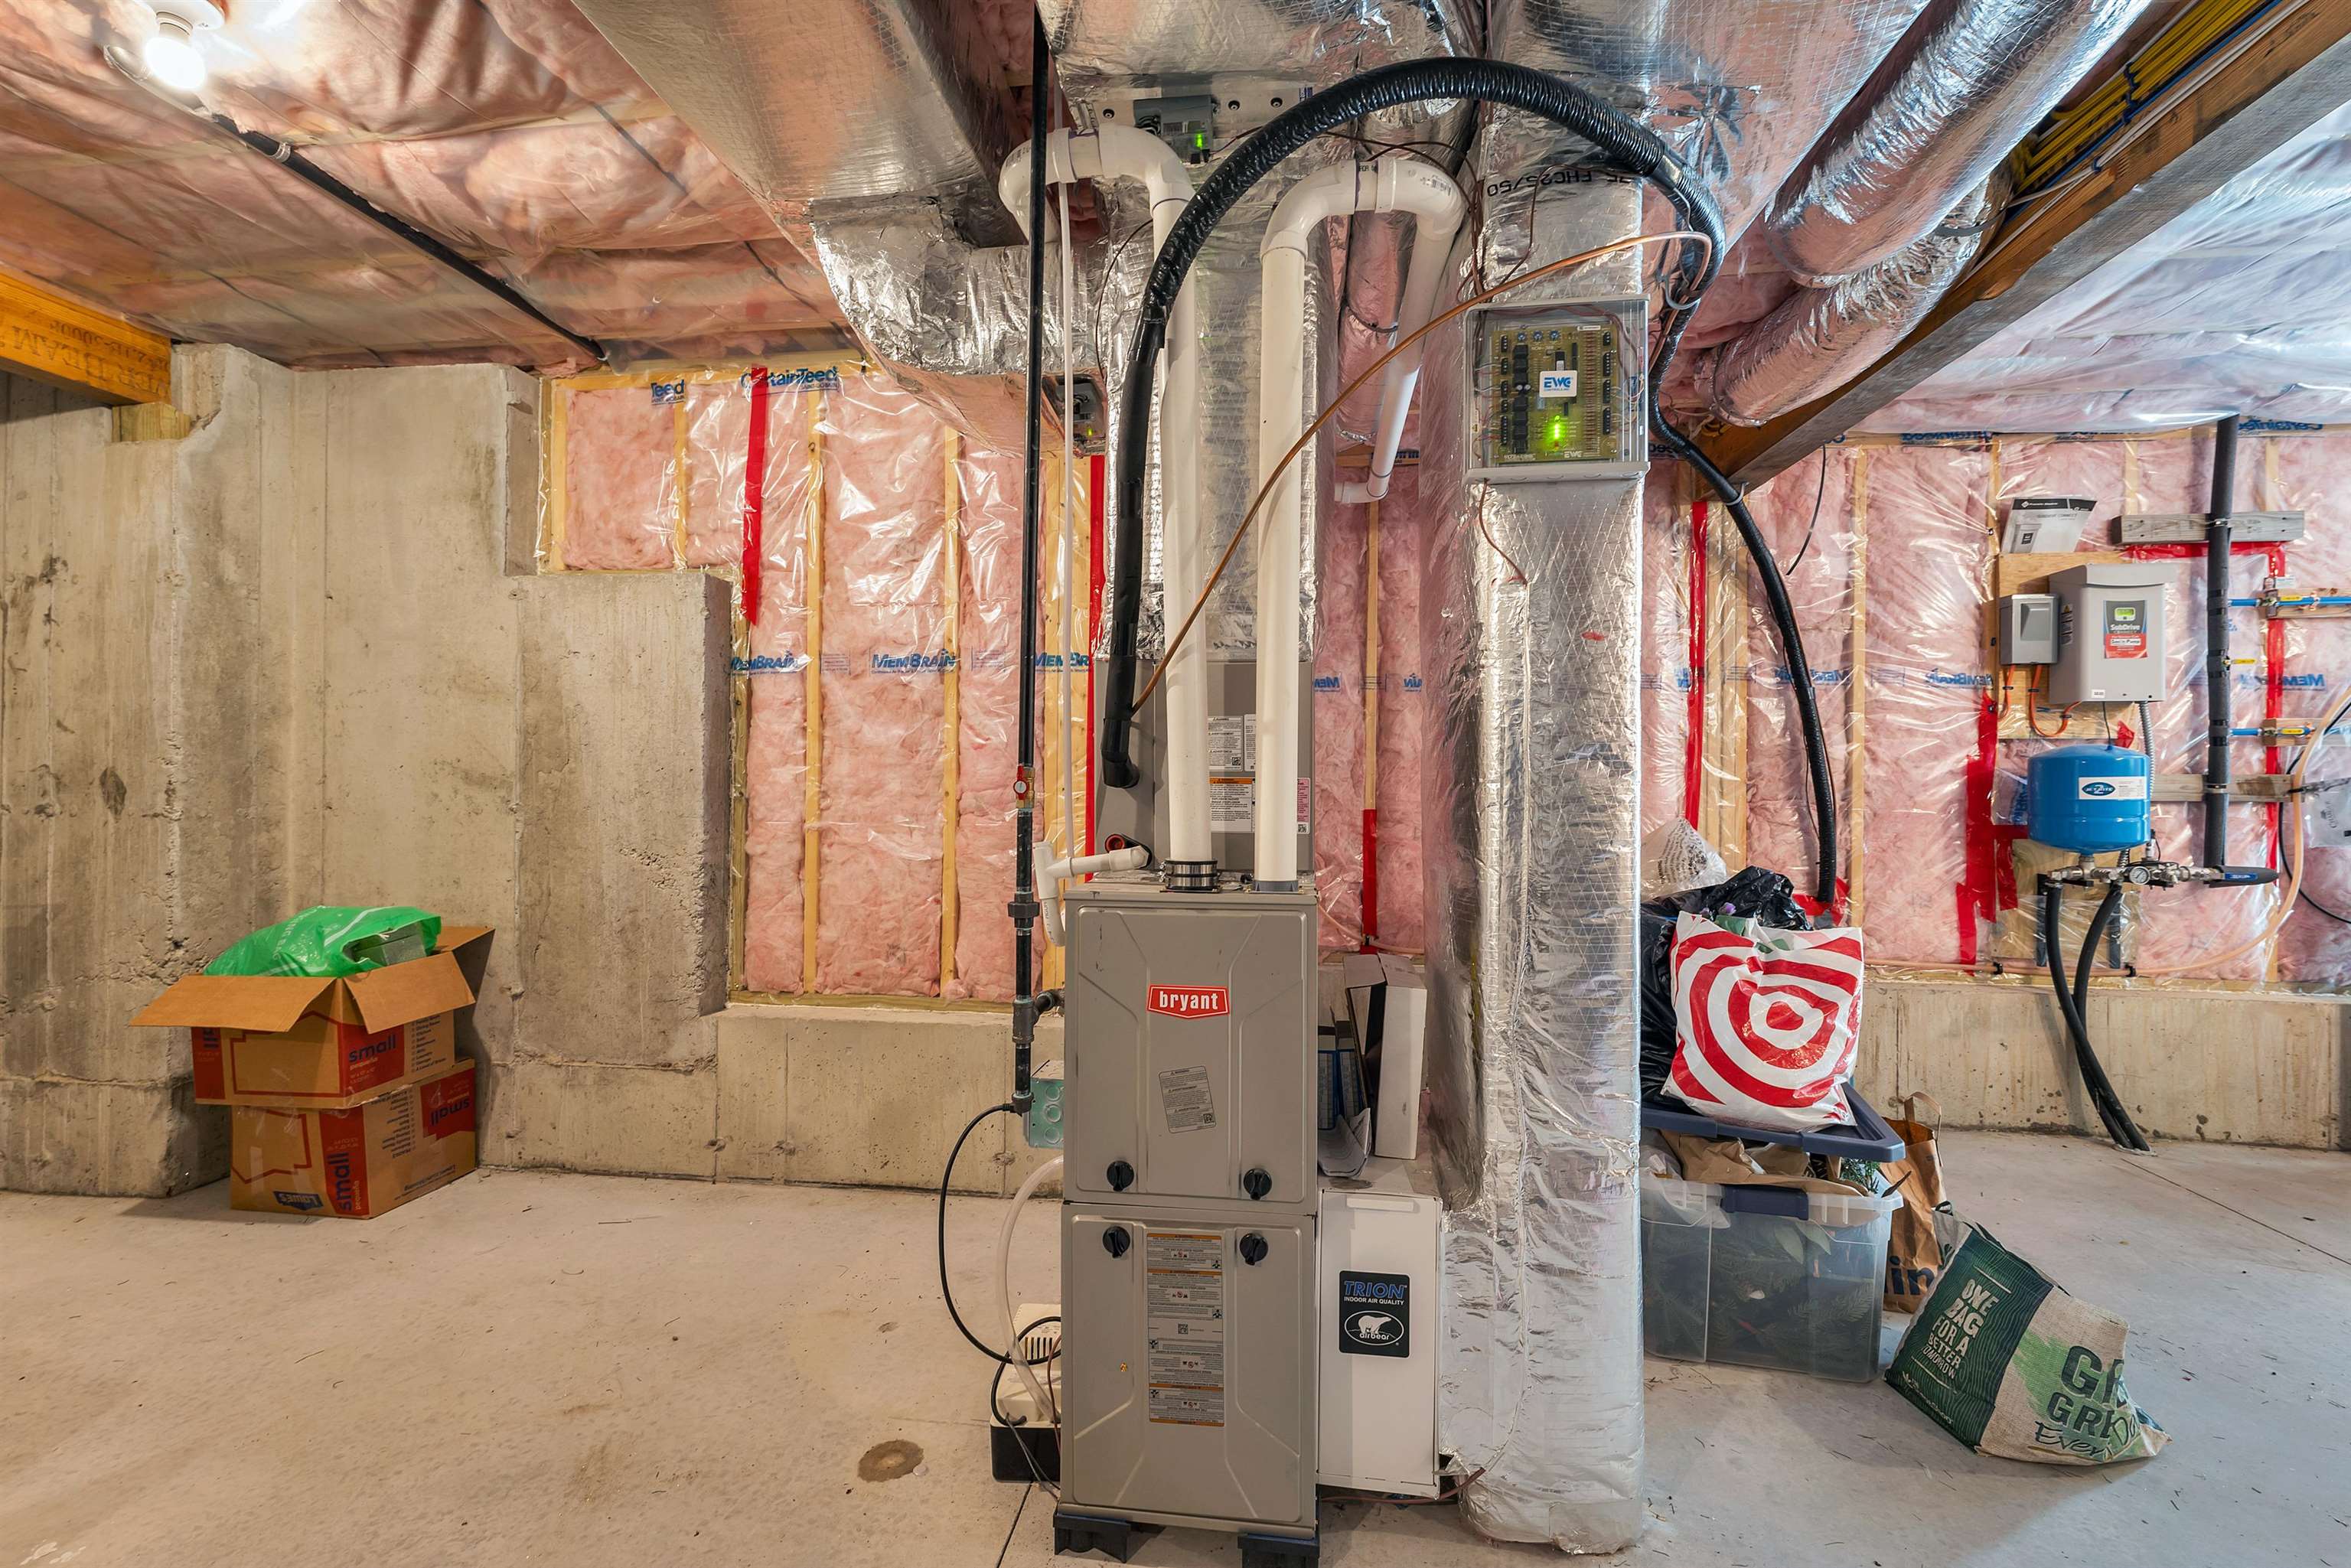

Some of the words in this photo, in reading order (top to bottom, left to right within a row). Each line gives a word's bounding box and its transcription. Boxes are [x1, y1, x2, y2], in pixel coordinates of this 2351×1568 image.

[740, 366, 838, 389] CtainTeed
[1544, 377, 1571, 388] EWC
[1159, 990, 1218, 1012] bryant
[349, 1034, 396, 1062] small
[431, 1097, 470, 1126] small
[327, 1152, 353, 1212] small
[1344, 1280, 1405, 1299] TRION
[1961, 1279, 2000, 1317] ONE
[1945, 1297, 1984, 1338] BAG
[1359, 1332, 1390, 1341] airbear
[1928, 1332, 1961, 1369] BETTER
[1932, 1315, 1957, 1347] FOR
[1955, 1335, 1970, 1357] A
[1922, 1344, 1956, 1379] TOMORROW
